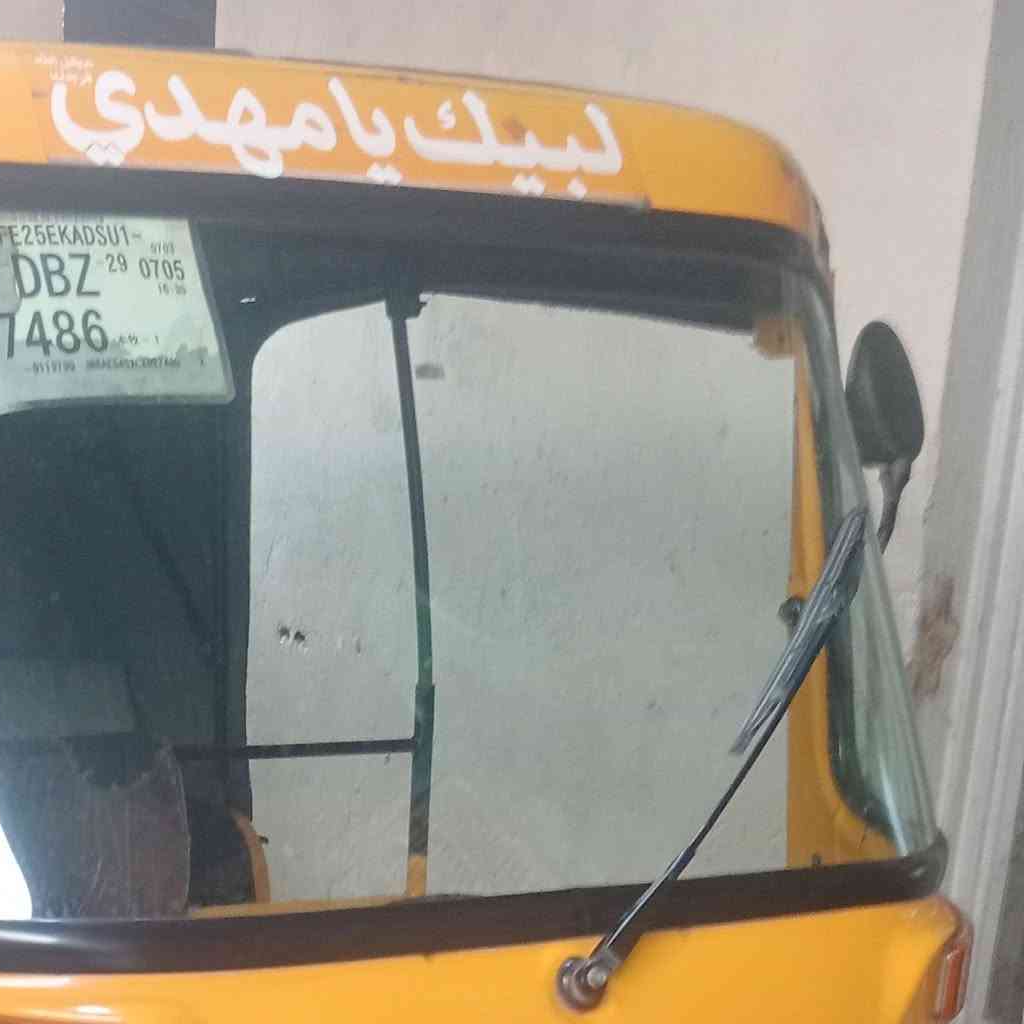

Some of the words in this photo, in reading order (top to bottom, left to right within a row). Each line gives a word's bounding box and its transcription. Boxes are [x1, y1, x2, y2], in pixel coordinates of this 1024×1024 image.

[403, 90, 623, 200] لبيك
[10, 252, 101, 298] DBZ
[106, 254, 128, 273] 29
[139, 259, 185, 281] 0705
